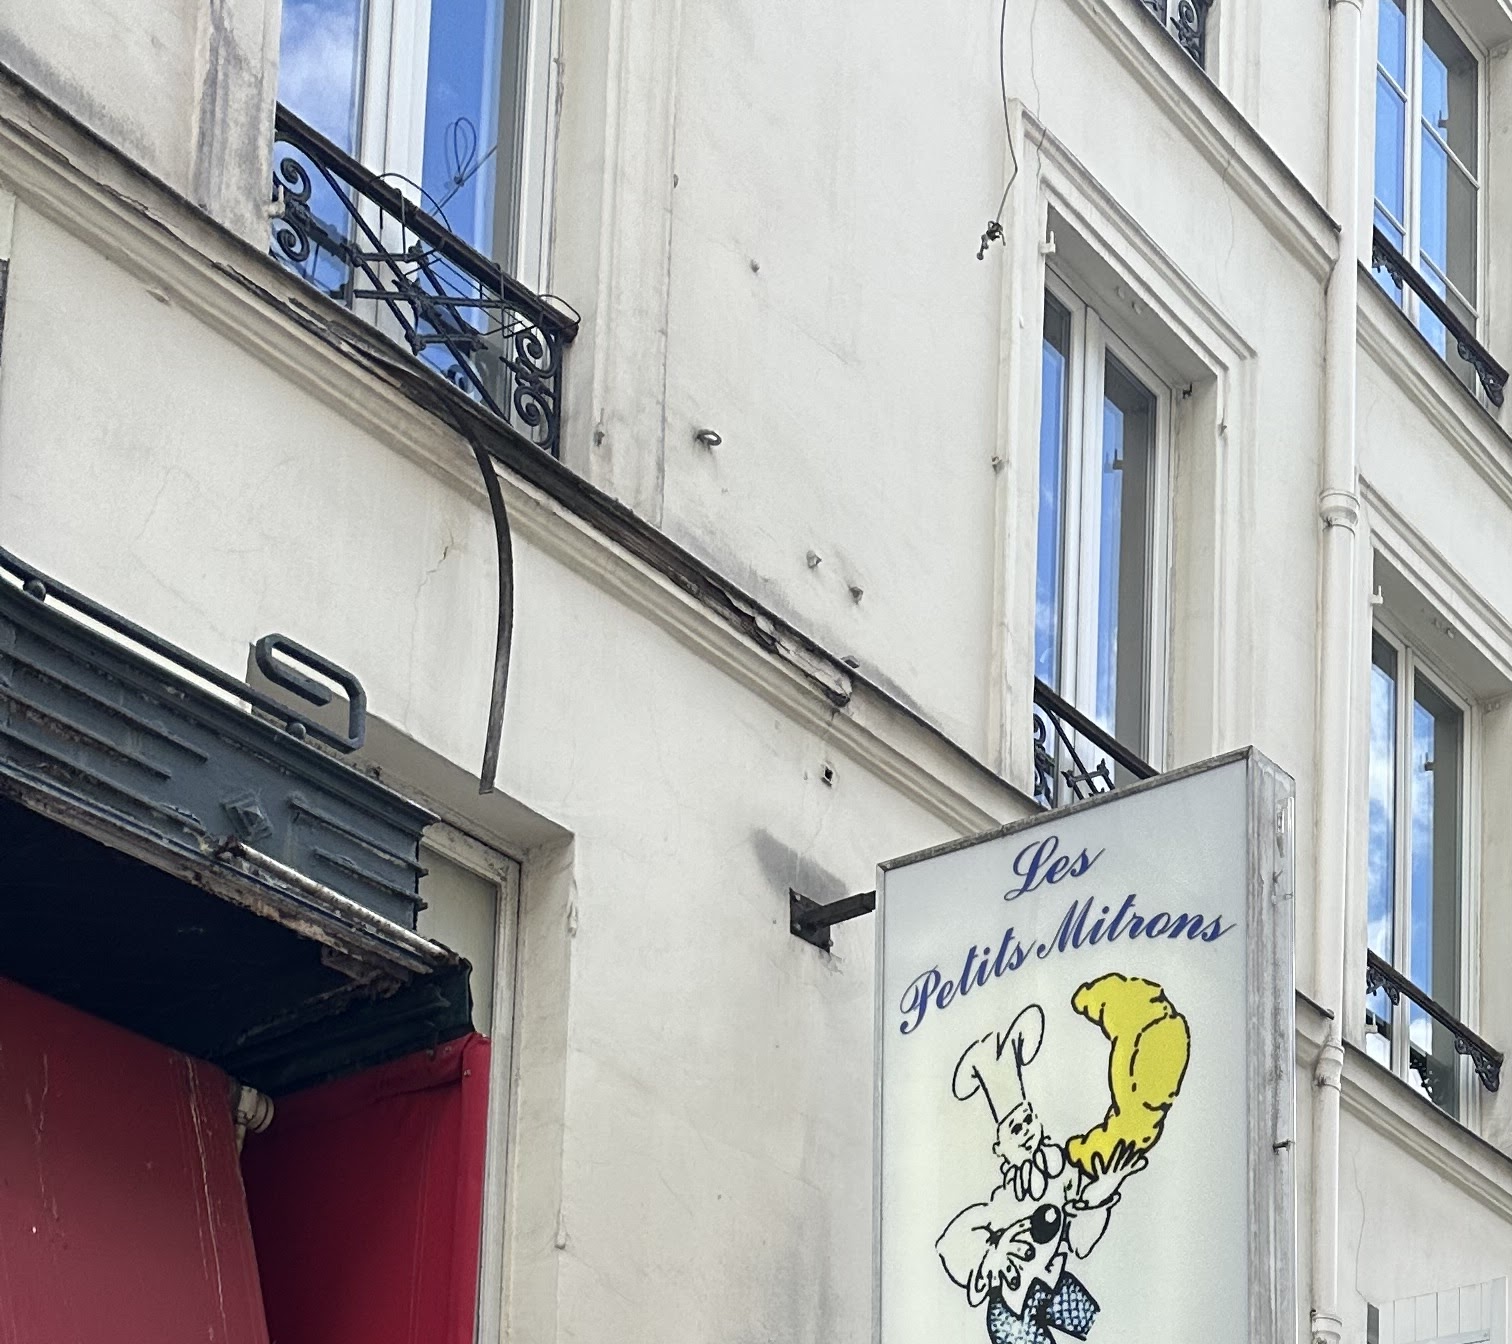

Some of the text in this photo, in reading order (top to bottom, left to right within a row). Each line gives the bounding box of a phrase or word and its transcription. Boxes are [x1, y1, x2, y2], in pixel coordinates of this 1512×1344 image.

[1004, 834, 1106, 902] Les
[898, 895, 1238, 1035] Petits Mitrons
